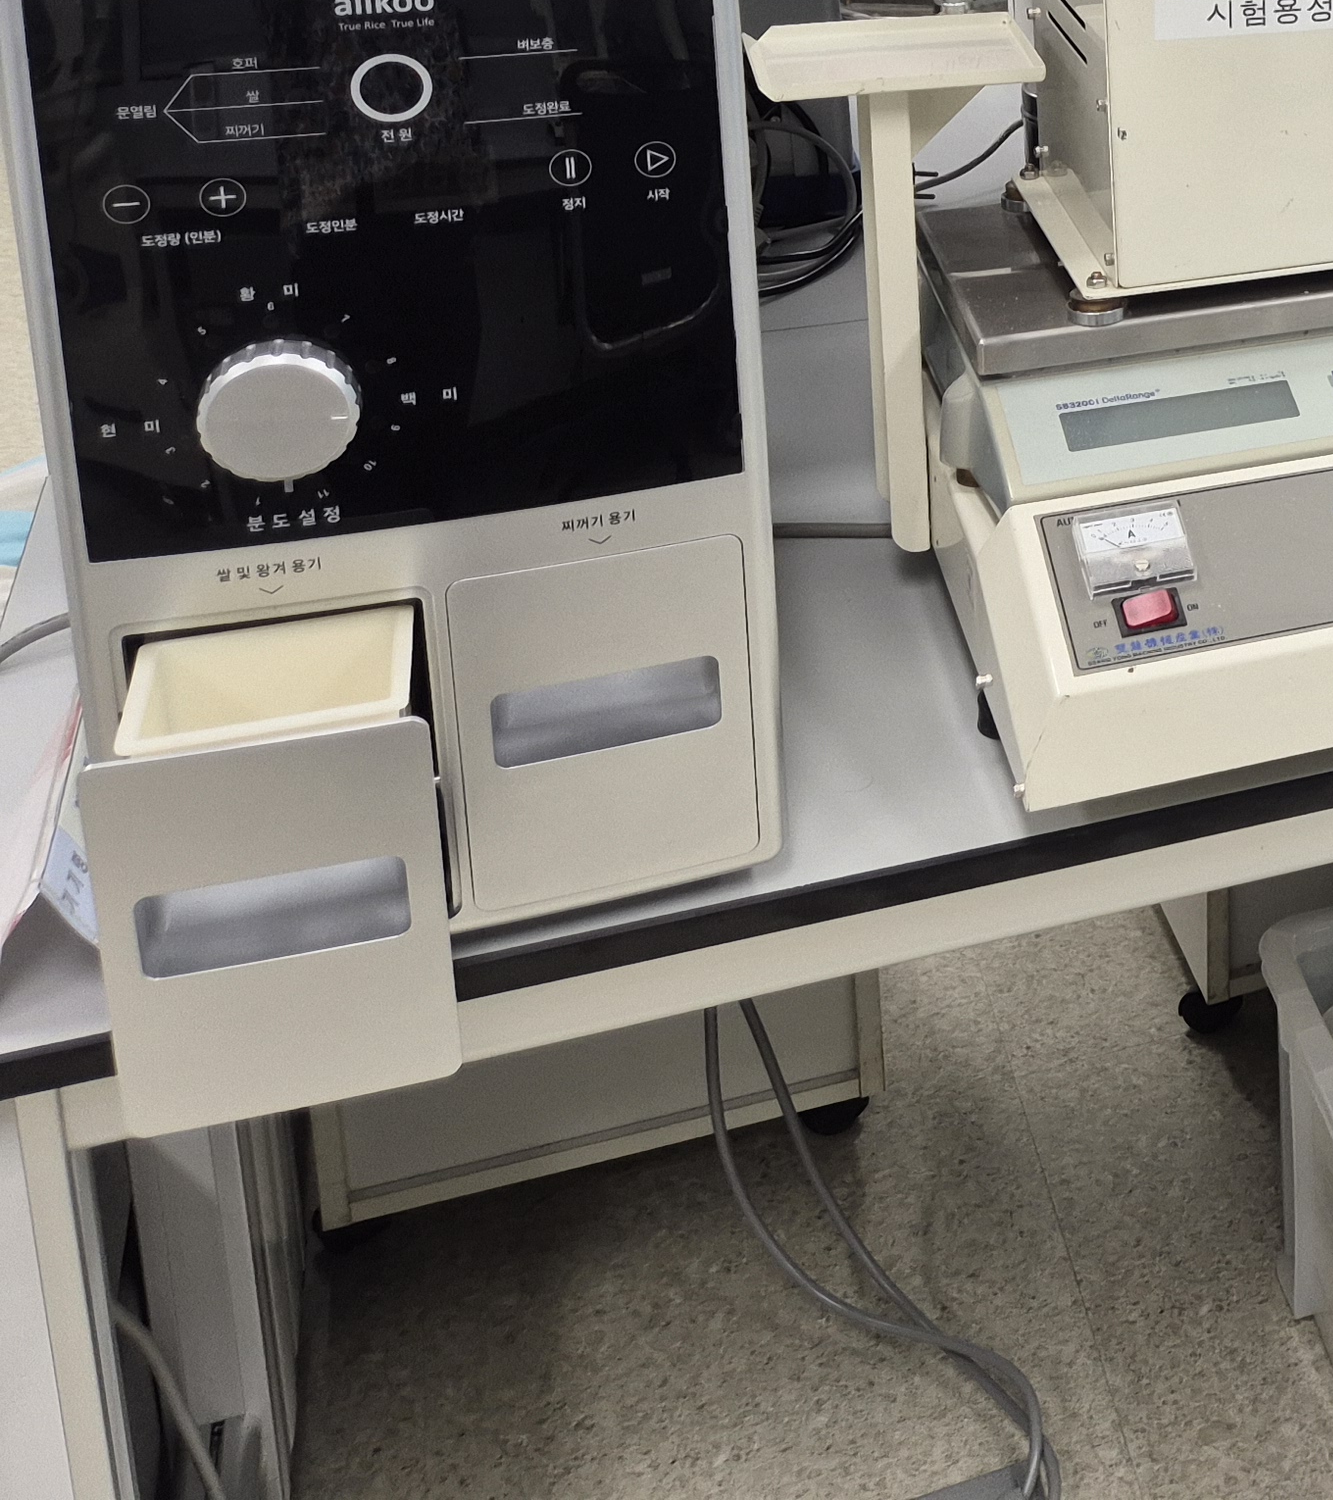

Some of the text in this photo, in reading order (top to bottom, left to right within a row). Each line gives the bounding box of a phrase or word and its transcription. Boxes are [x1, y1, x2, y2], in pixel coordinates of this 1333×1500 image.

[338, 16, 435, 32] True Rice True Life
[231, 56, 259, 70] 호퍼
[116, 104, 158, 120] 문열림
[522, 100, 571, 116] 도정완료
[225, 123, 265, 137] 찌꺼기
[646, 187, 670, 201] 시작
[561, 196, 587, 211] 정지
[414, 208, 465, 225] 도정시간
[305, 218, 358, 235] 도정인분
[141, 229, 222, 248] 도정량 (인분)
[561, 508, 636, 532] 찌꺼기 용기
[216, 556, 323, 583] 쌀 및 왕겨 용기
